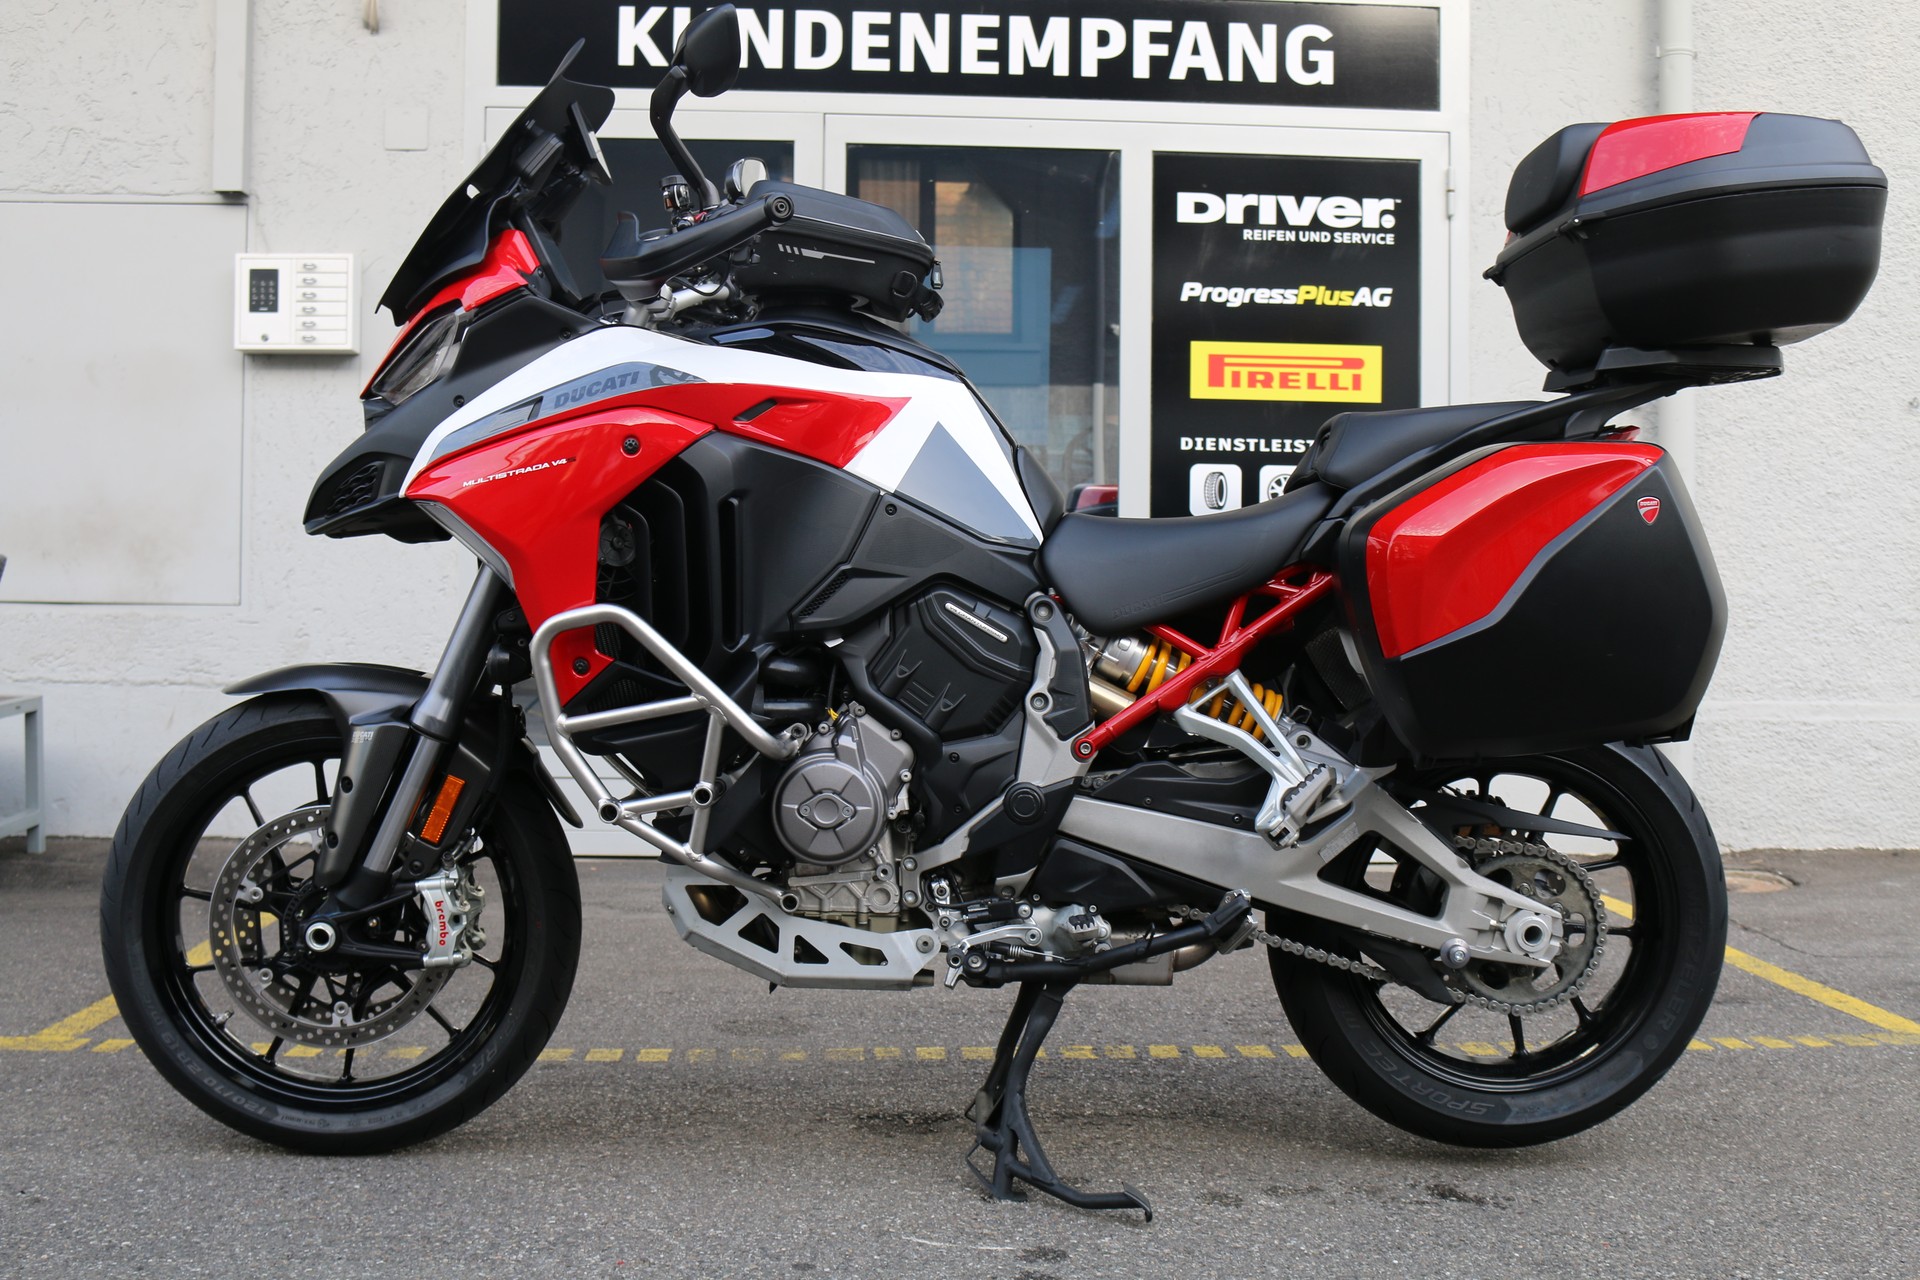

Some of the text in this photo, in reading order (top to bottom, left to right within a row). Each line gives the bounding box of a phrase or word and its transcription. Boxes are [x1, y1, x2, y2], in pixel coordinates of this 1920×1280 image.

[1243, 229, 1395, 245] REIFEN UND SERVICE
[554, 371, 639, 409] DUCATI
[1208, 354, 1365, 391] PIRELLI
[462, 463, 550, 488] MULTISTRADA
[434, 900, 449, 946] brembo
